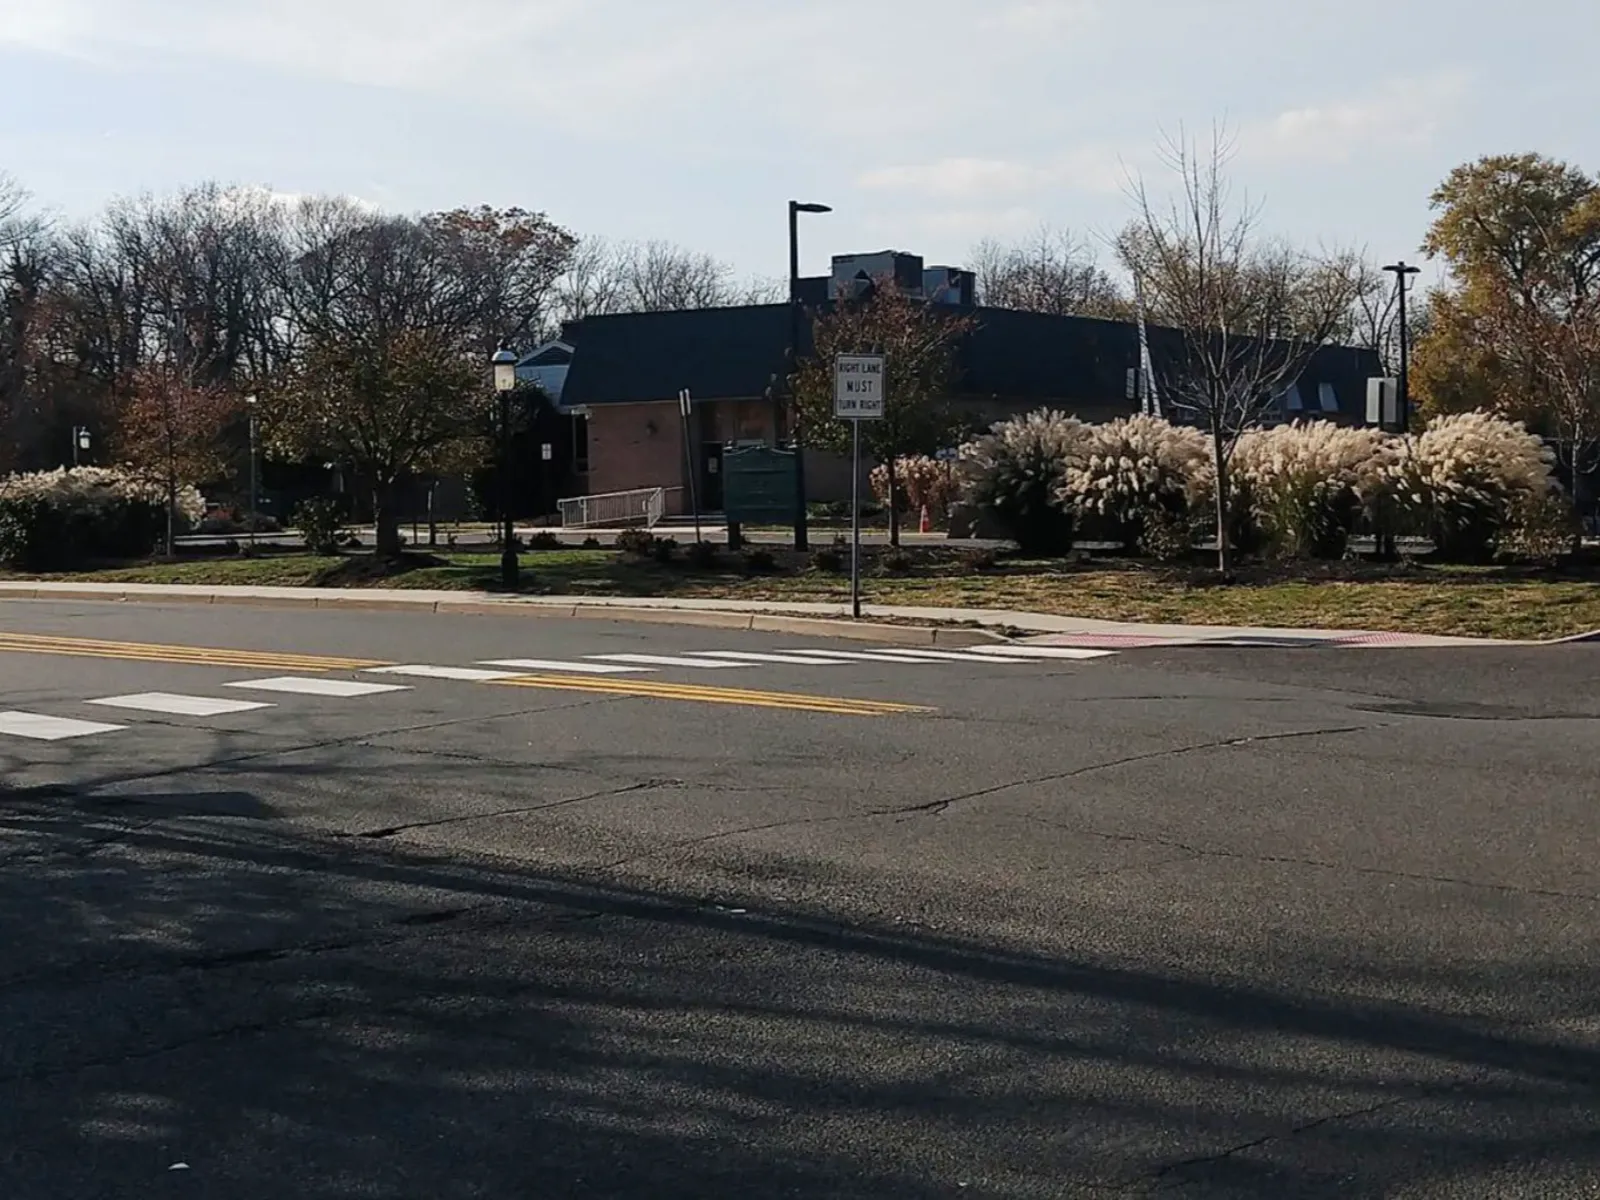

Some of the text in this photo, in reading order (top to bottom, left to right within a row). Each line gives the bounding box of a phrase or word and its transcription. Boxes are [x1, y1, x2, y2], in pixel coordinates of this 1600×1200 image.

[838, 362, 881, 374] RIGHT LANE
[846, 380, 872, 392] MUST
[838, 400, 880, 410] TURN RIGHT
